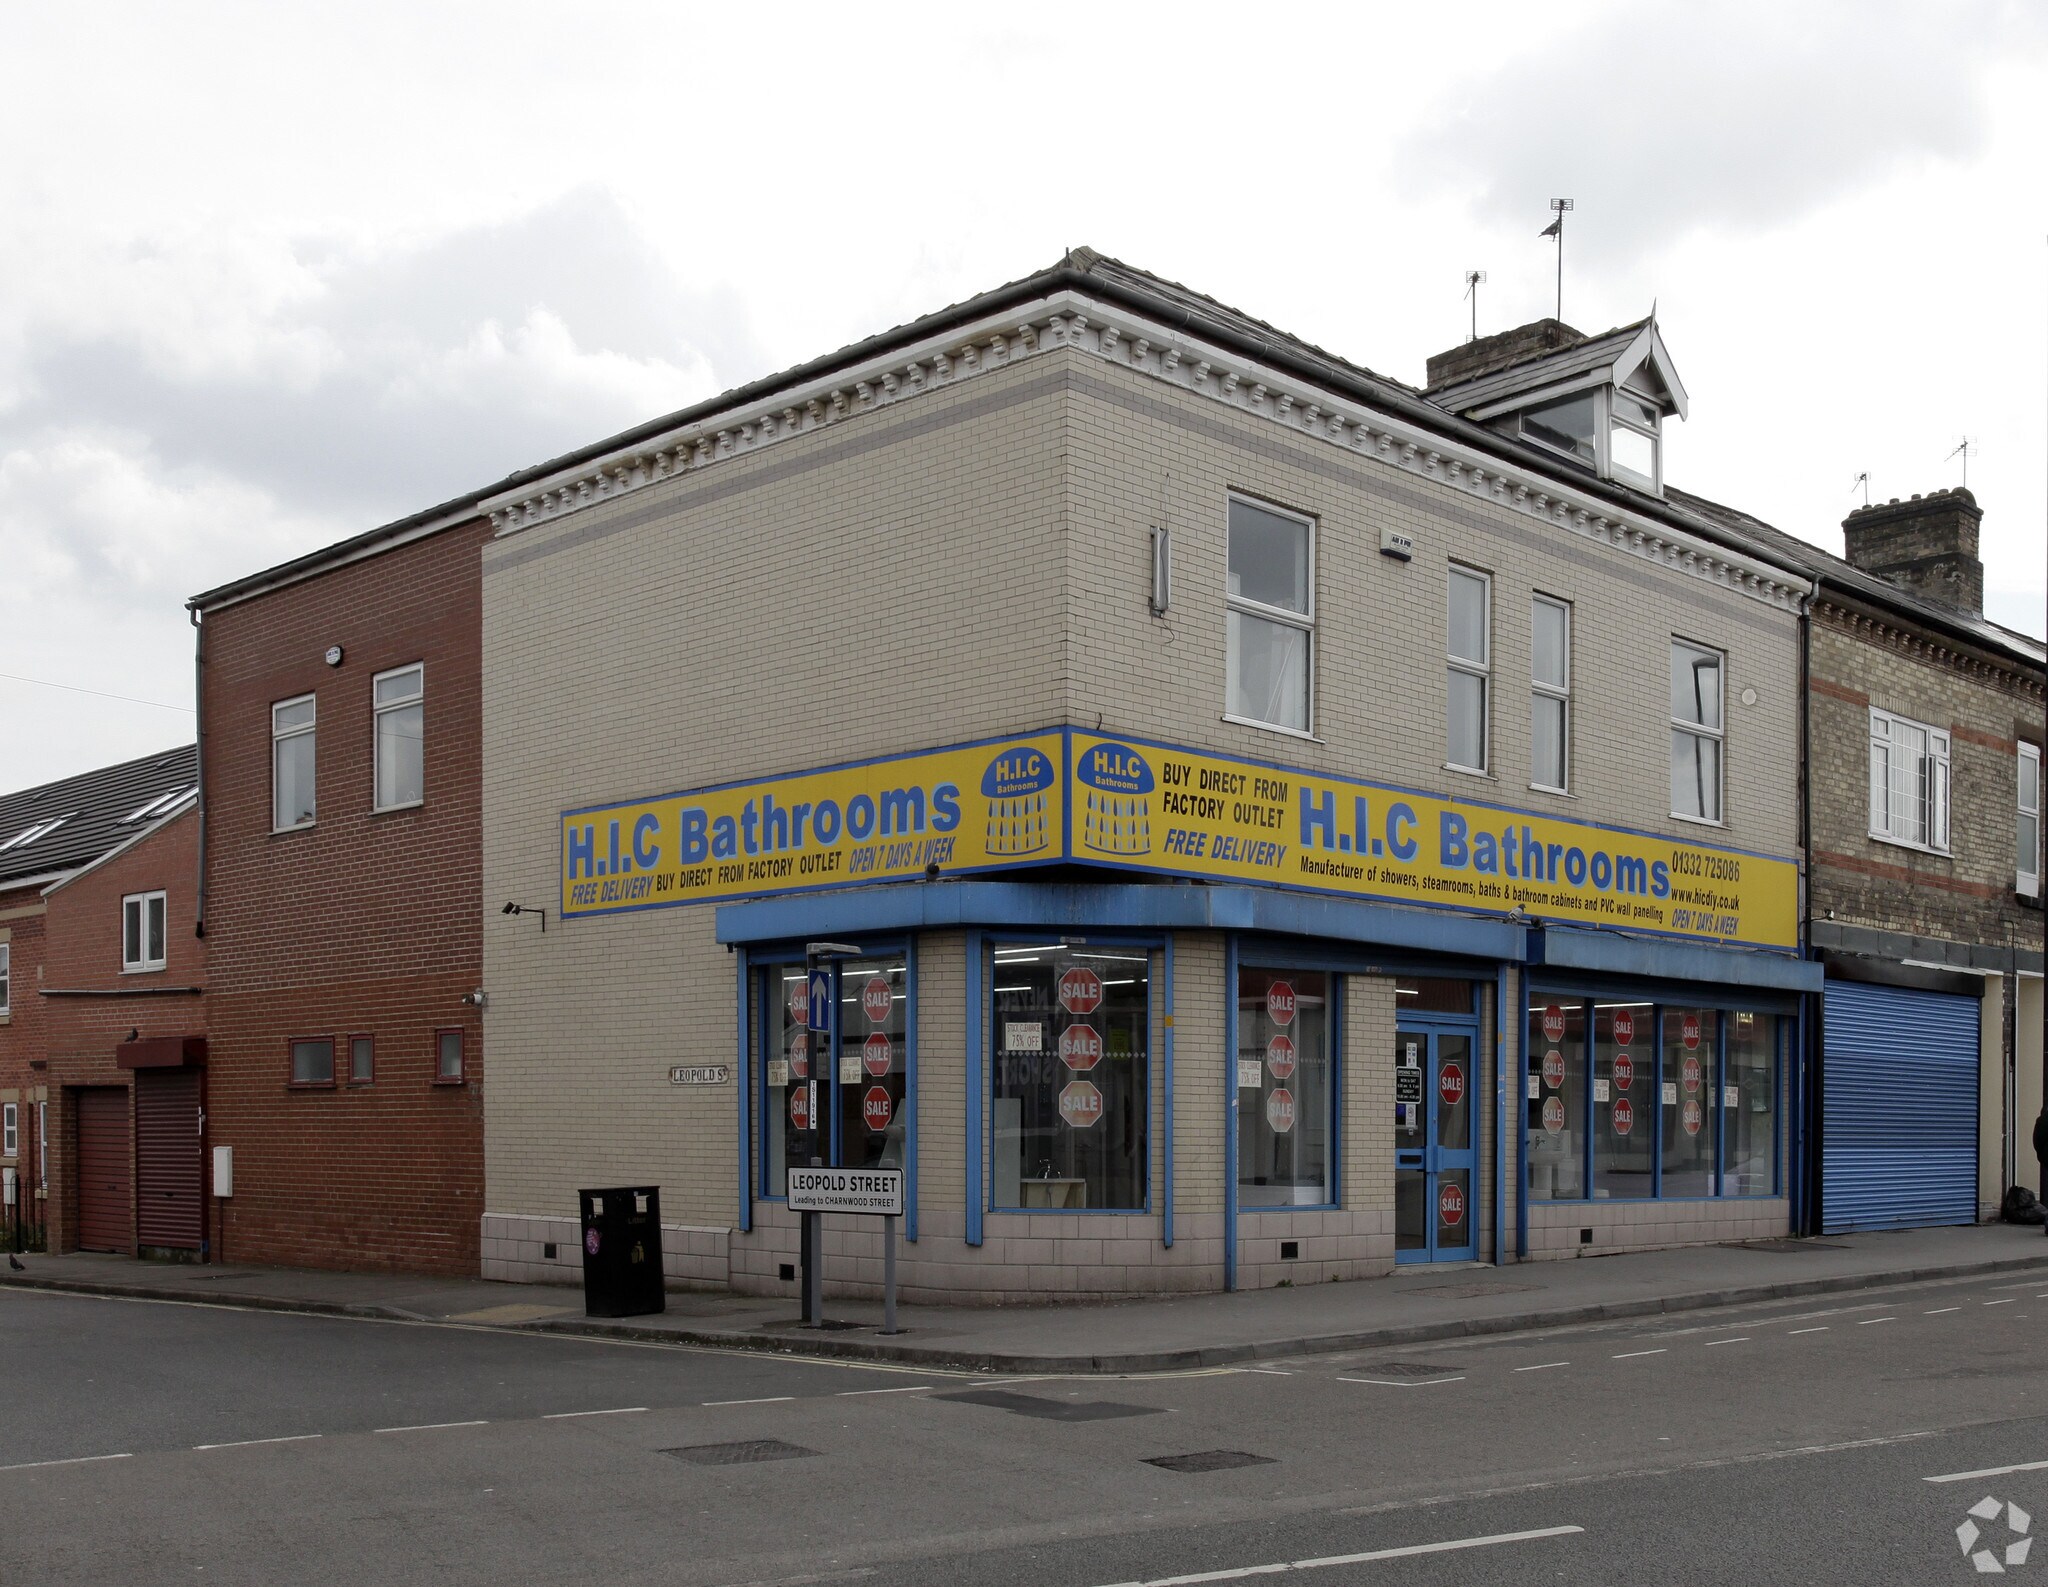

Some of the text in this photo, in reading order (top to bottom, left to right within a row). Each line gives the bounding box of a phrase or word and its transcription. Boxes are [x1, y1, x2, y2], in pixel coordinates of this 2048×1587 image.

[995, 755, 1041, 782] H.I.C
[1094, 750, 1141, 778] H.I.C
[997, 781, 1038, 794] Bathrooms
[1095, 776, 1139, 790] Bathrooms
[1163, 762, 1288, 803] BUY DIRECT FROM
[1162, 791, 1284, 830] FACTORY OUTLET
[567, 781, 963, 880] H.I.C Bathrooms
[1163, 828, 1288, 869] FREE DELIVERY
[1300, 786, 1672, 899] H.I.C Bathrooms
[850, 837, 956, 874] OPEN 7 DAYS A WEEK
[656, 851, 842, 891] BUY DIRECT FROM FACTORY OUTLET
[1672, 850, 1740, 882] 01332 725086
[570, 876, 654, 906] FREE DELIVERY
[1300, 855, 1664, 924] Manufacturer of showers, steamrooms, baths & bathroom cabinets and PVC wall panelling
[1671, 888, 1740, 911] www.hicdiy.co.uk
[1671, 908, 1740, 936] OPEN 7 DAYS A WEEK
[1062, 982, 1098, 998] SALE
[793, 996, 807, 1010] SAL
[866, 992, 889, 1007] SALE
[1270, 995, 1293, 1011] SALE
[1545, 1016, 1562, 1030] SALE
[1615, 1021, 1632, 1035] SALE
[1683, 1026, 1699, 1039] SALE
[1012, 1034, 1040, 1047] 75% OFF
[1062, 1039, 1098, 1055] SALE
[866, 1047, 889, 1062] SALE
[1270, 1048, 1293, 1065] SALE
[673, 1069, 715, 1081] LEOPOLD
[1545, 1062, 1562, 1076] SALE
[1615, 1066, 1631, 1079] SALE
[1683, 1068, 1699, 1082] SALE
[1442, 1076, 1461, 1091] SALE
[793, 1101, 807, 1115] SAL
[866, 1101, 889, 1116] SALE
[1062, 1095, 1098, 1112] SALE
[1270, 1101, 1292, 1119] SALE
[1544, 1108, 1562, 1123] SALE
[1614, 1110, 1631, 1124] SALE
[1684, 1112, 1699, 1125] SALE
[792, 1174, 897, 1193] LEOPOLD STREET
[794, 1196, 895, 1207] Leading to CHARNWOOD STREET
[1442, 1197, 1461, 1211] SALE
